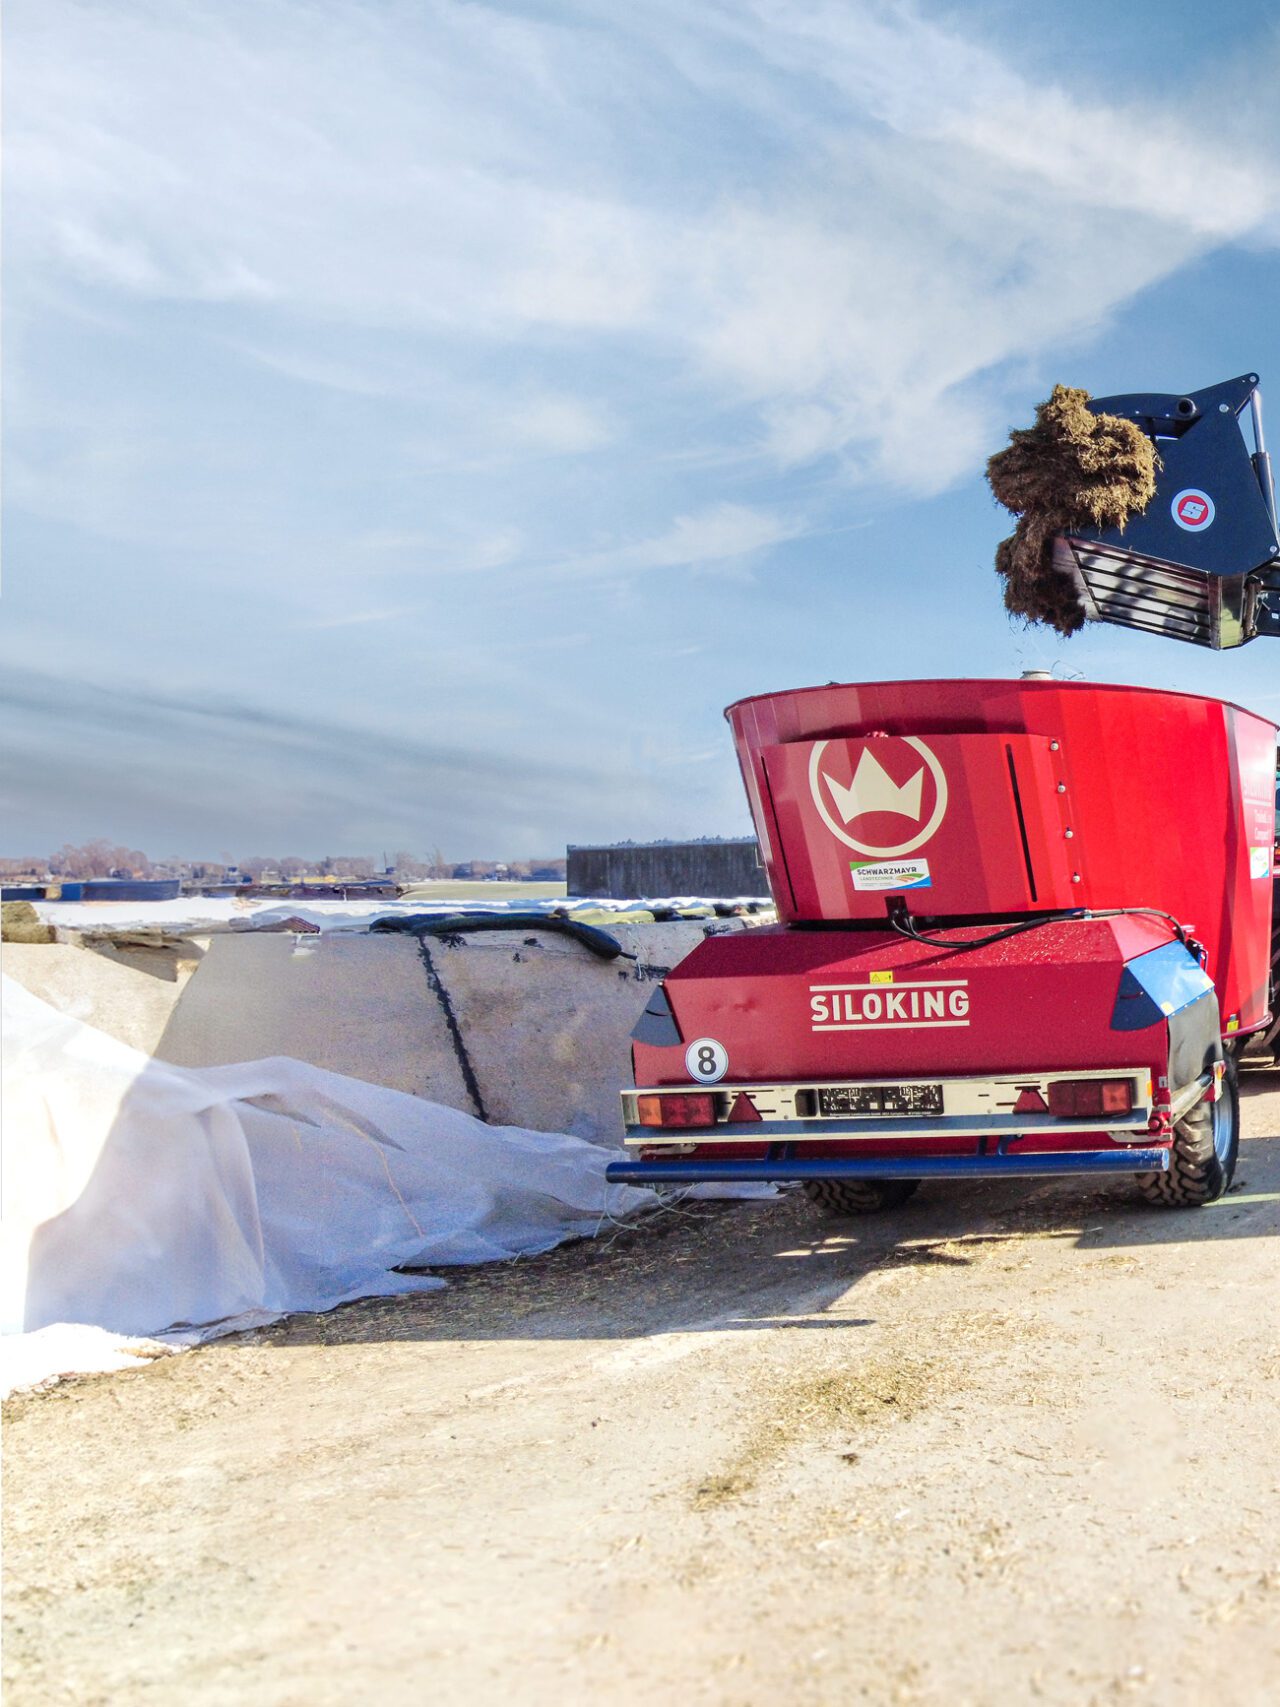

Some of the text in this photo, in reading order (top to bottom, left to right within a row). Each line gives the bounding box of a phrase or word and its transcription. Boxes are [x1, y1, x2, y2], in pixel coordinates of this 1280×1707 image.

[856, 866, 917, 876] SCHWARZMAYR
[810, 990, 970, 1022] SILOKING
[697, 1046, 717, 1075] 8
